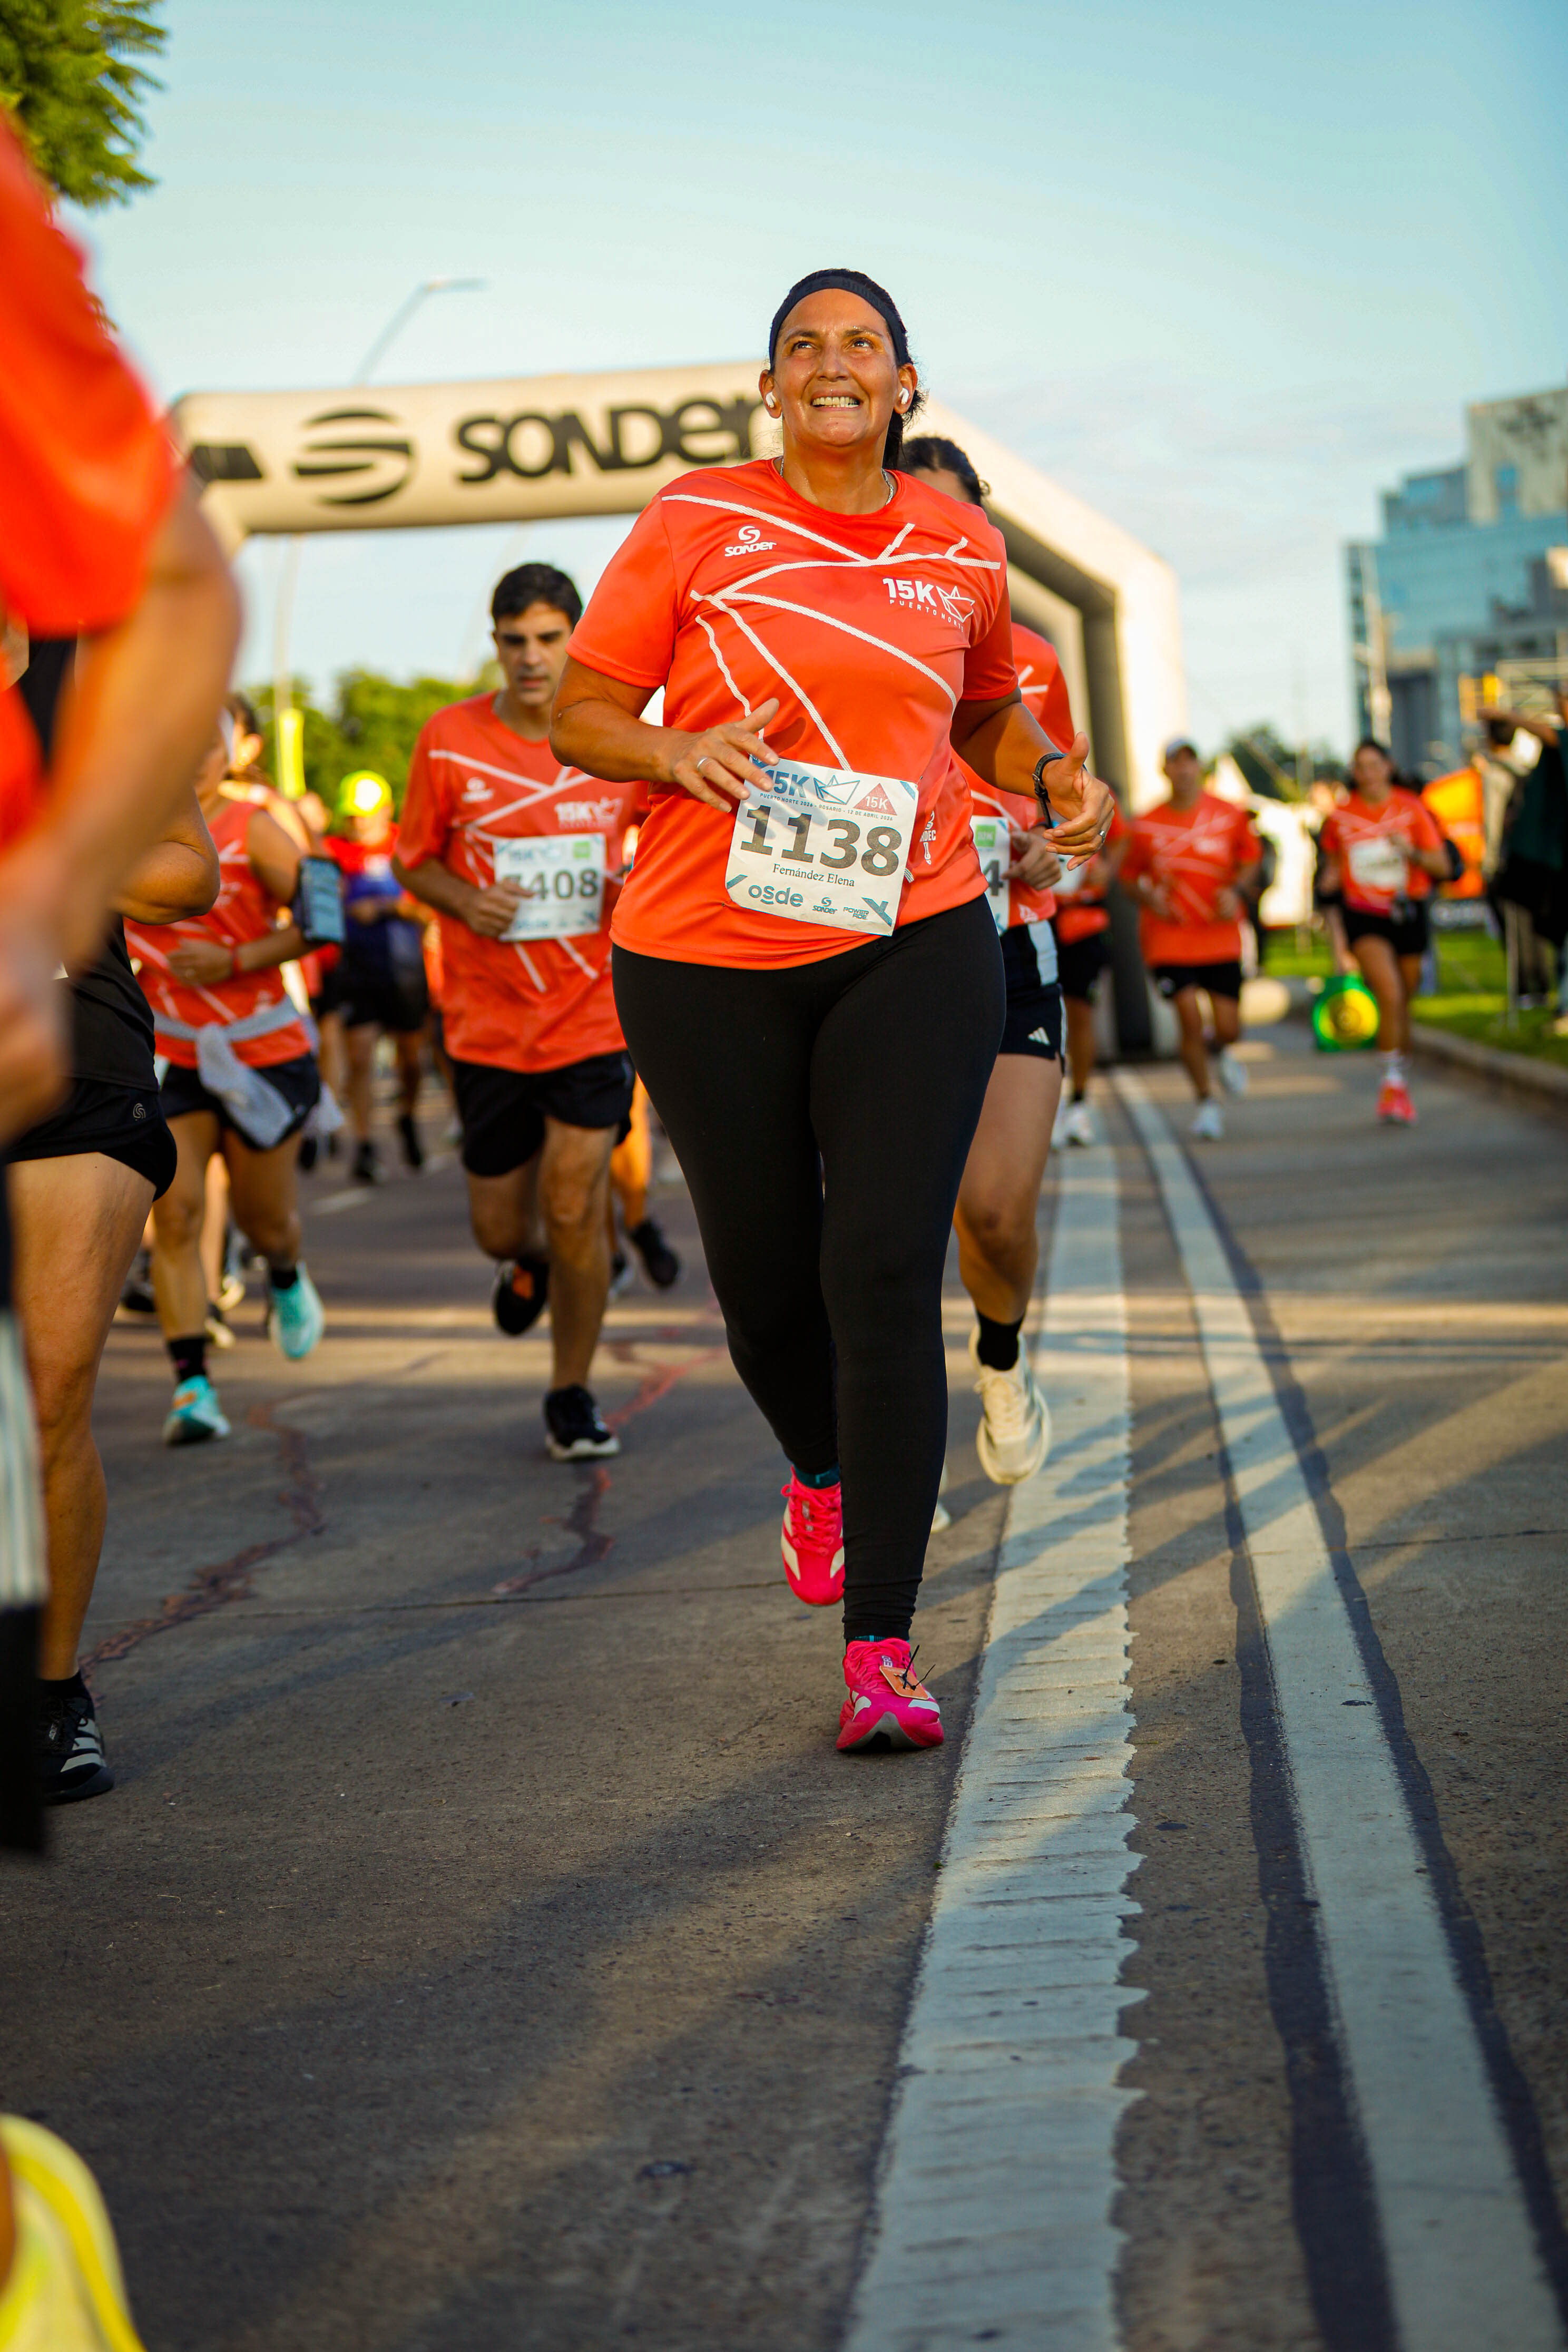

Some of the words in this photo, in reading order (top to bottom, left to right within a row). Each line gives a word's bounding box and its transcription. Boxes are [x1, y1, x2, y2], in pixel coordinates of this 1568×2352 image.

[883, 577, 937, 607] 15K
[889, 599, 937, 616] PUERTO
[818, 804, 842, 813] ROSARIO
[865, 796, 888, 810] 15K
[740, 805, 903, 877] 1138
[504, 868, 599, 901] 408
[772, 863, 825, 883] Fernández
[827, 873, 855, 887] Elena
[748, 885, 803, 907] osde
[843, 907, 869, 916] POWER
